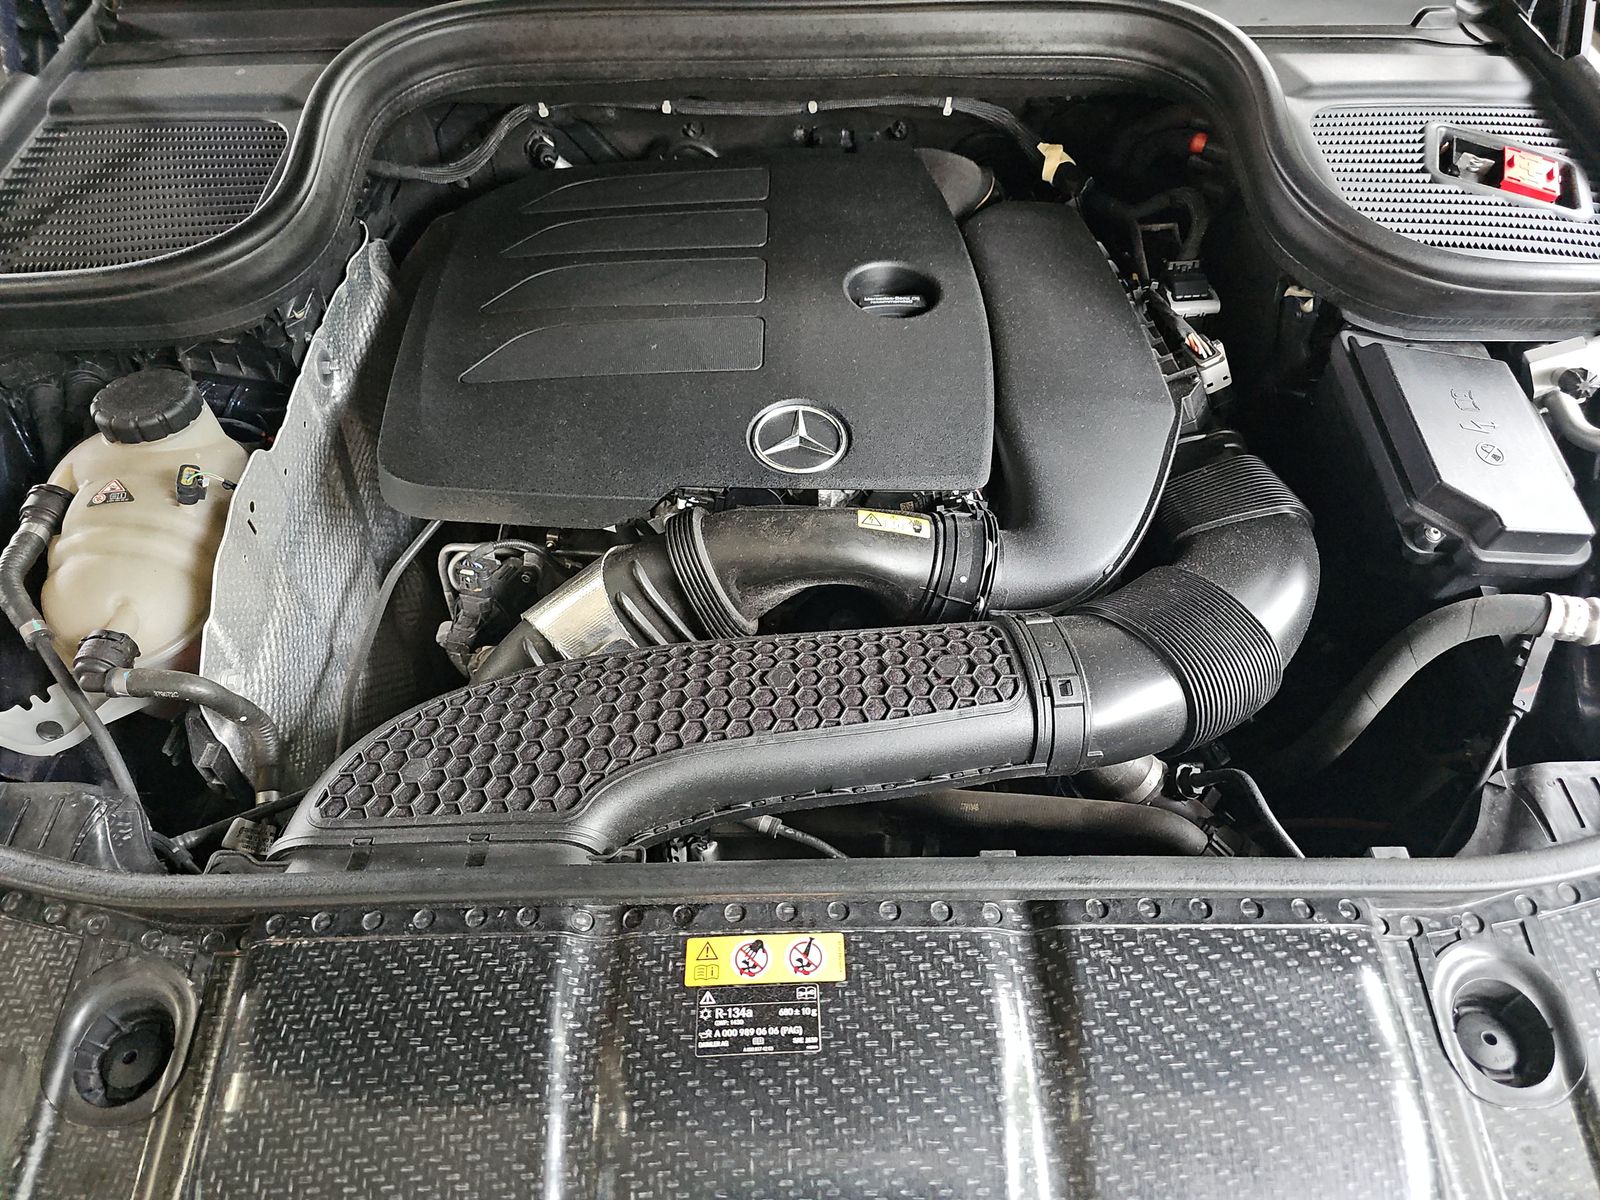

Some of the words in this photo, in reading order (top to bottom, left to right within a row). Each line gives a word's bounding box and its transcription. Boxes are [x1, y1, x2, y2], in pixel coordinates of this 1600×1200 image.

[715, 1007, 753, 1019] R-134a
[722, 1029, 738, 1037] 000
[739, 1028, 755, 1036] 989
[756, 1027, 767, 1036] 06
[768, 1027, 779, 1035] 06
[781, 1026, 803, 1037] (PAG)
